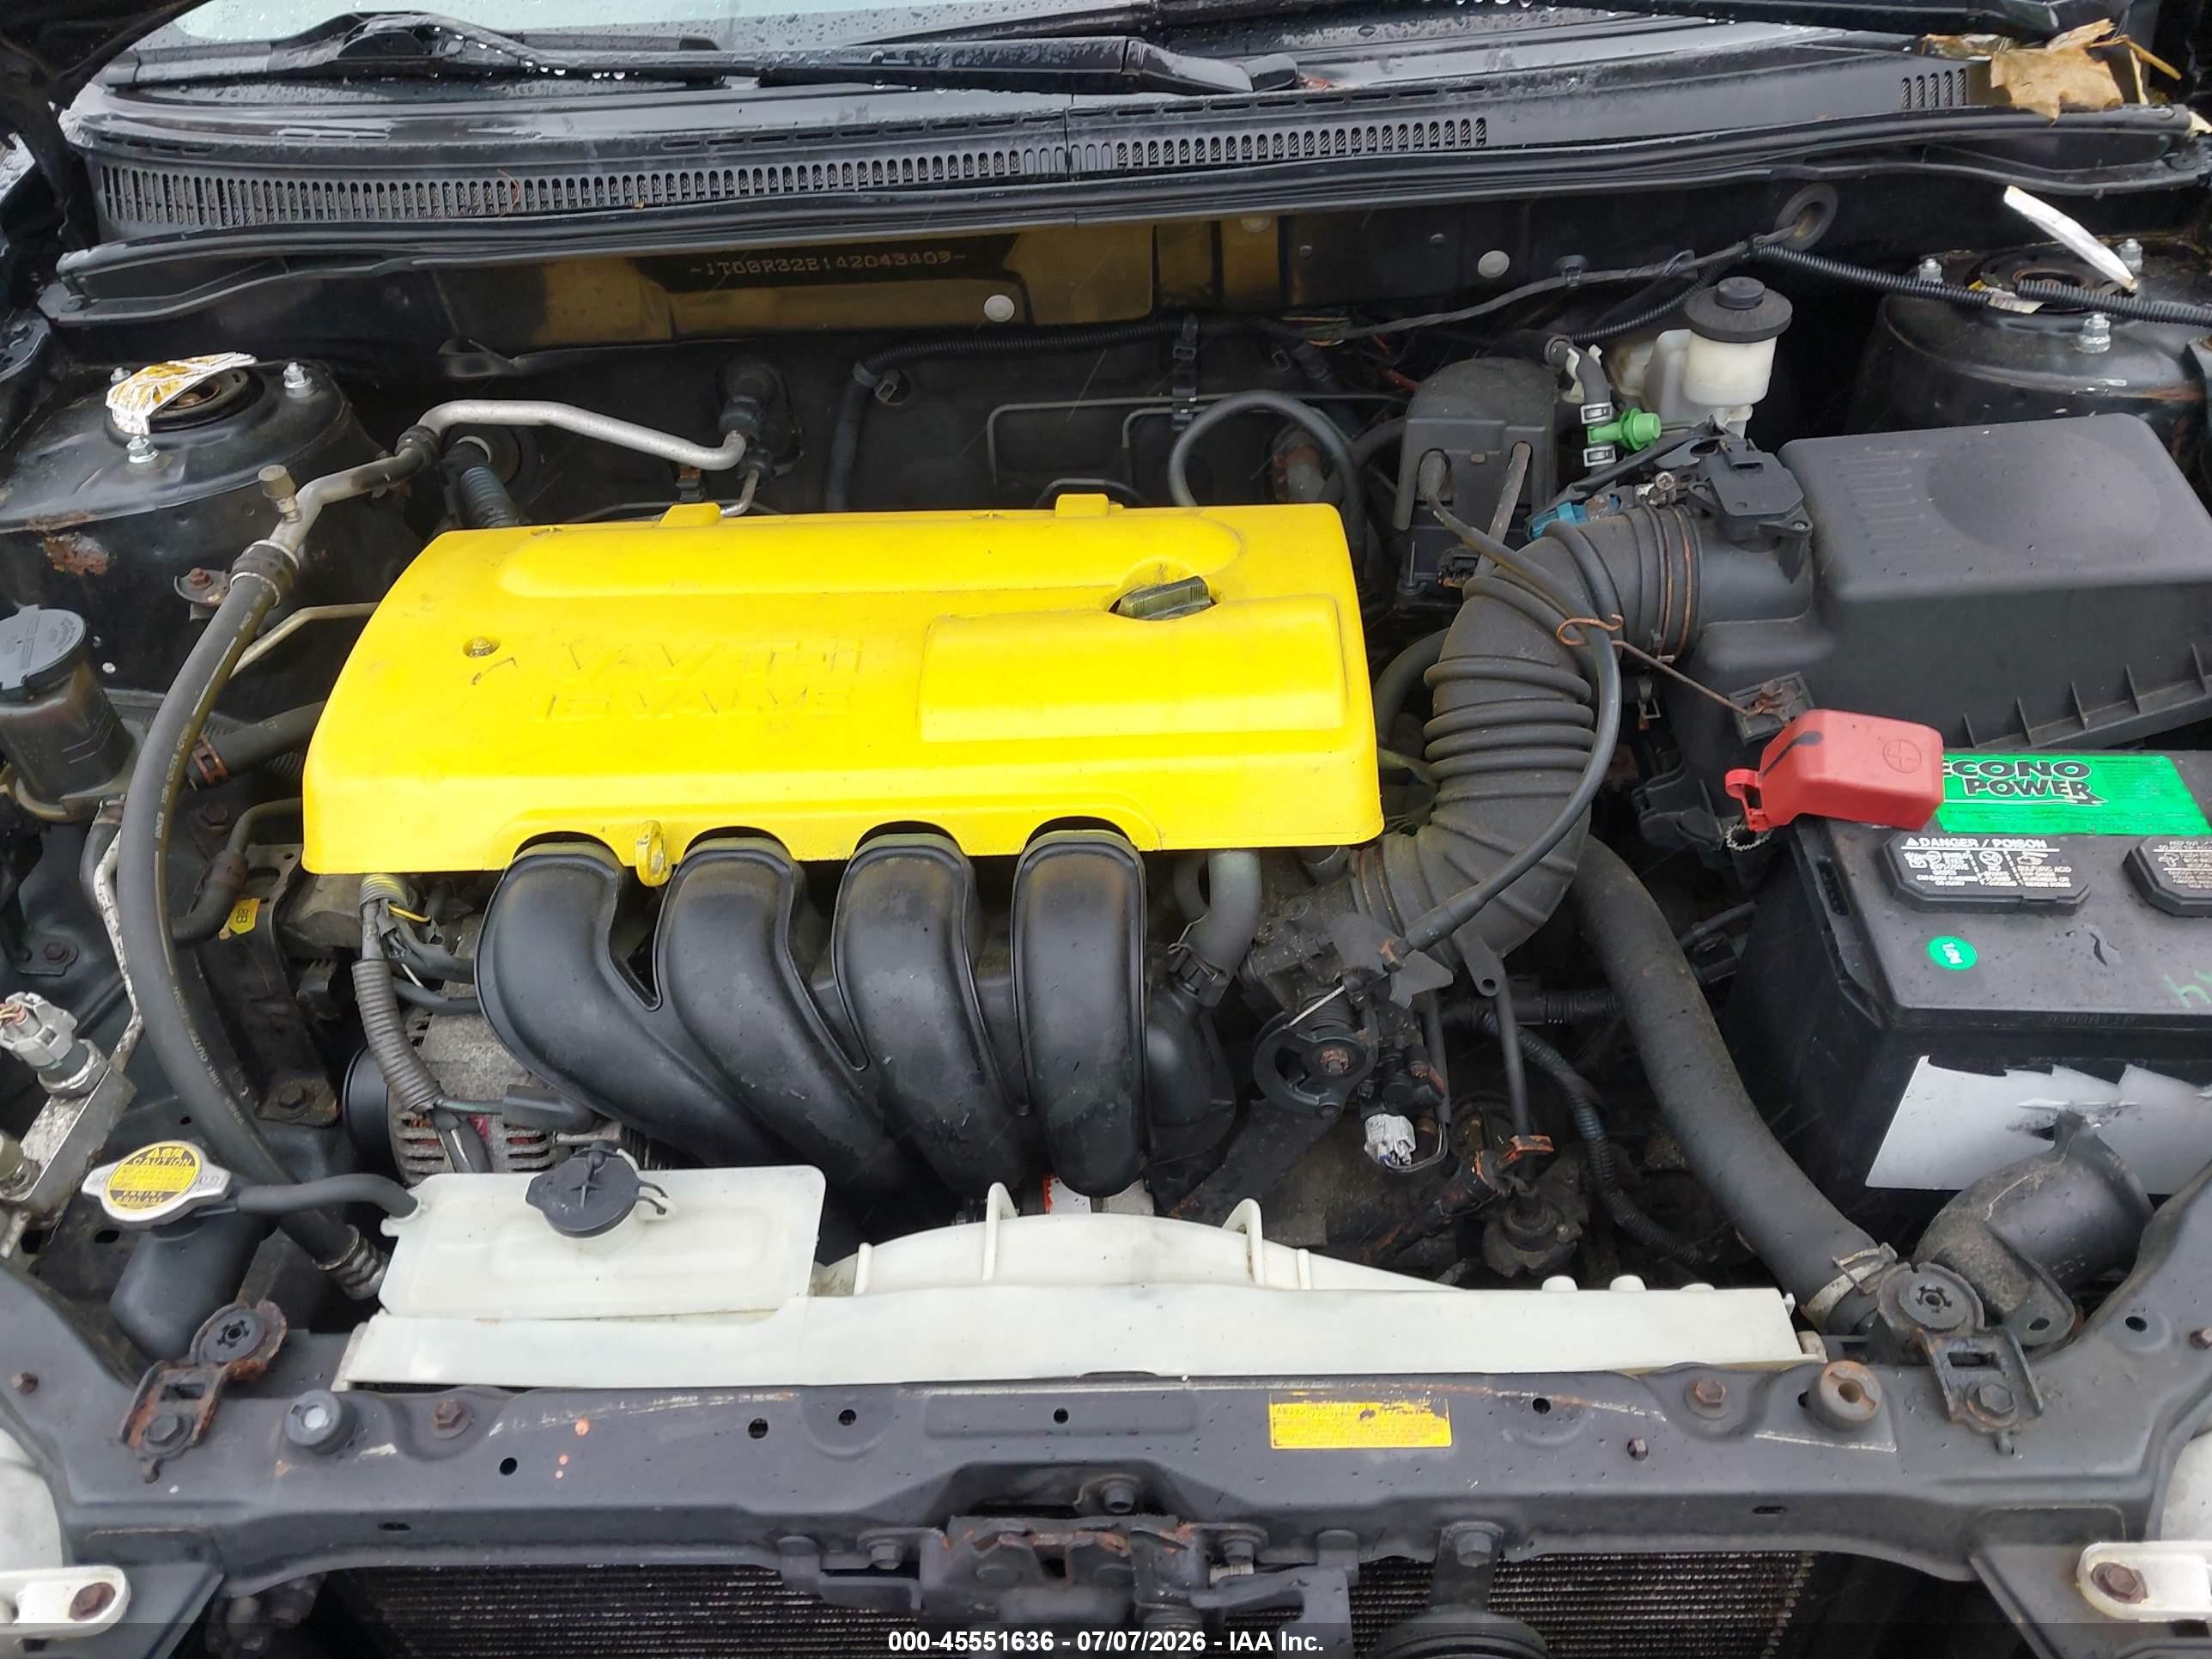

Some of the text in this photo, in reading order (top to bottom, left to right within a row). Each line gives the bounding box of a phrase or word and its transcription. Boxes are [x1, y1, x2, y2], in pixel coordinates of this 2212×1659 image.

[1965, 777, 2102, 803] POWER
[1918, 837, 1979, 848] DANGER
[1991, 838, 2049, 848] POISON
[132, 1156, 193, 1168] CAUTION
